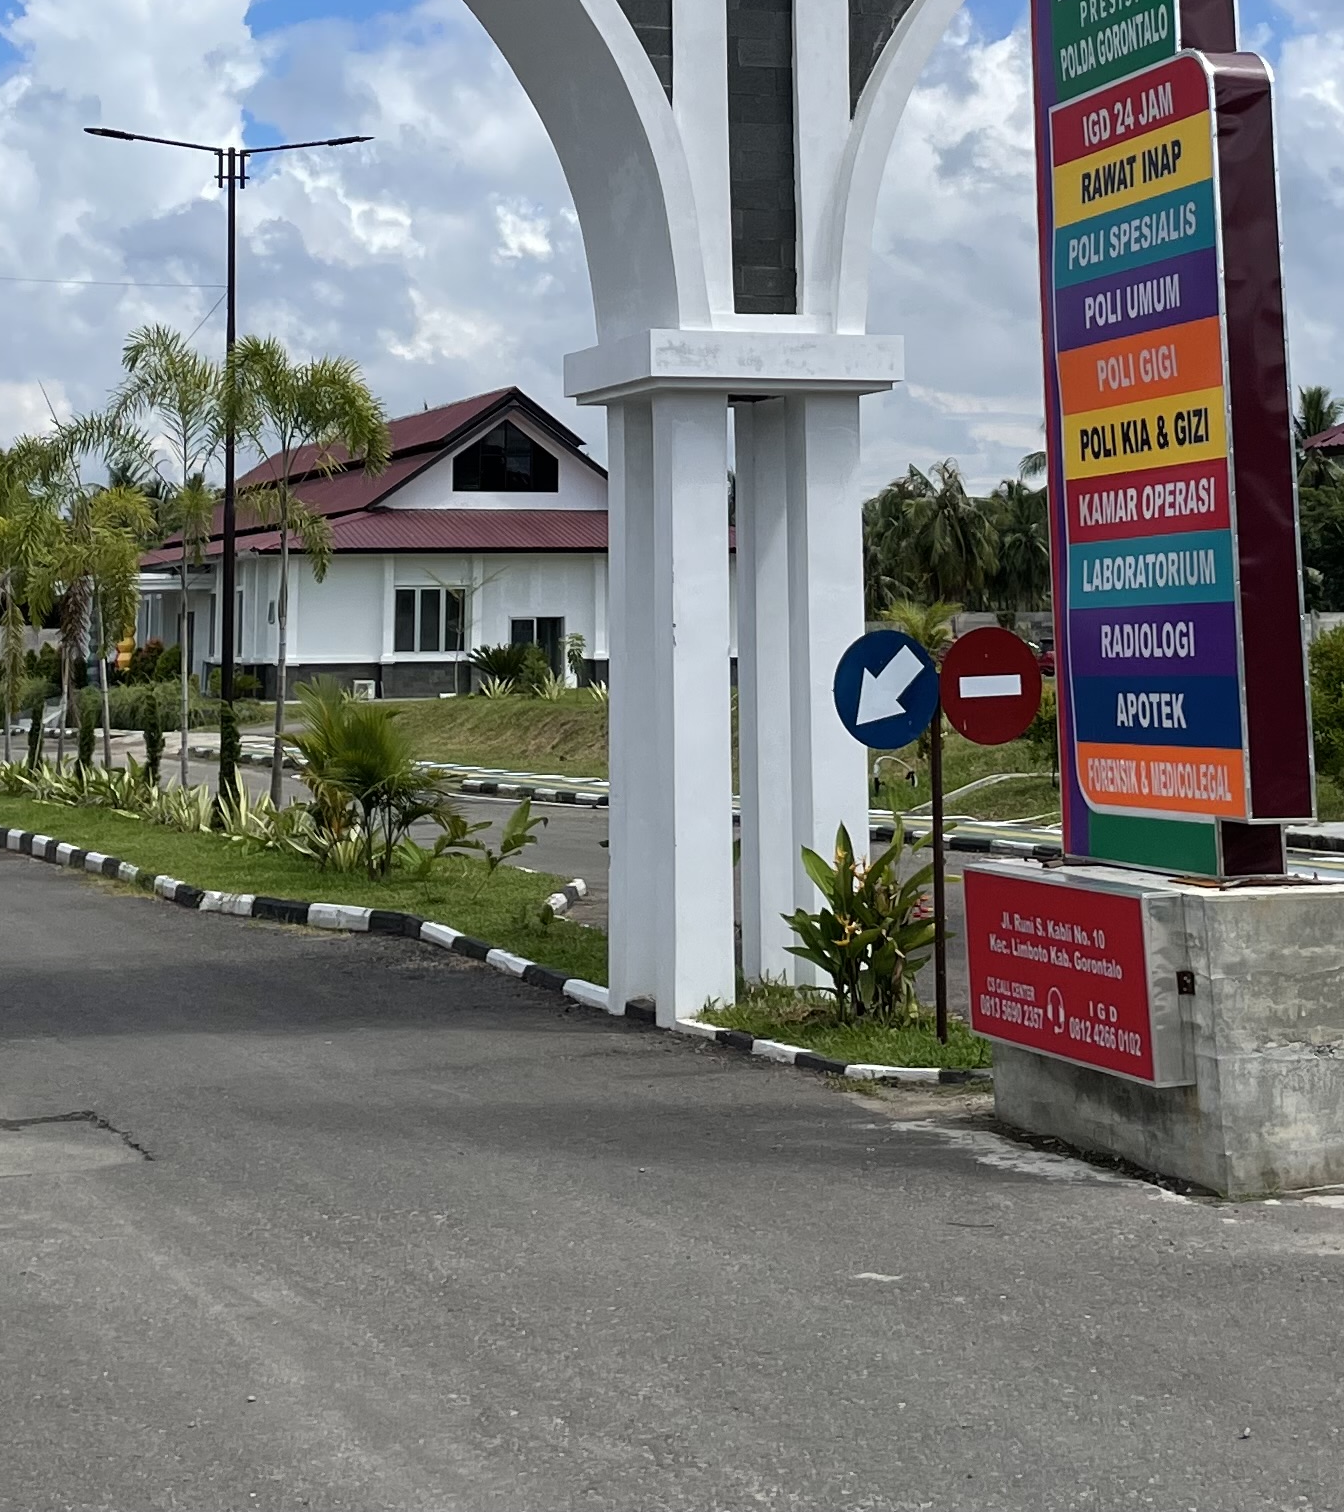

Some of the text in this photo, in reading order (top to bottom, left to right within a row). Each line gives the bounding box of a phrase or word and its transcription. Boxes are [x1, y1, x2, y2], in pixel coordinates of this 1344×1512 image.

[1060, 4, 1169, 82] POLDA GORONTALO
[1082, 82, 1174, 148] IGD 24 JAM
[1081, 139, 1182, 204] RAWAT INAP
[1068, 201, 1197, 270] POLI SPESIALIS
[1084, 273, 1181, 329] POLI UMUM
[1096, 344, 1178, 392] POLI GIGI
[1080, 407, 1210, 462] POLI KIA & GIZI
[1078, 476, 1216, 527] KAMAR OPERASI
[1082, 548, 1217, 593] LABORATORIUM
[1101, 621, 1196, 658] RADIOLOGI
[1116, 692, 1188, 729] APOTEK
[1088, 757, 1233, 802] FORENSIK & MEDICOLEGAL
[989, 933, 1123, 980] Kec. Limboto Kab. Gorontalo
[1035, 917, 1046, 937] S.
[1073, 924, 1091, 946] No.
[1092, 928, 1106, 950] 10
[980, 993, 1001, 1019] 0813
[996, 978, 1011, 996] CALL
[1011, 981, 1036, 1002] CENTER
[1069, 1016, 1142, 1057] 0812 4266 0102
